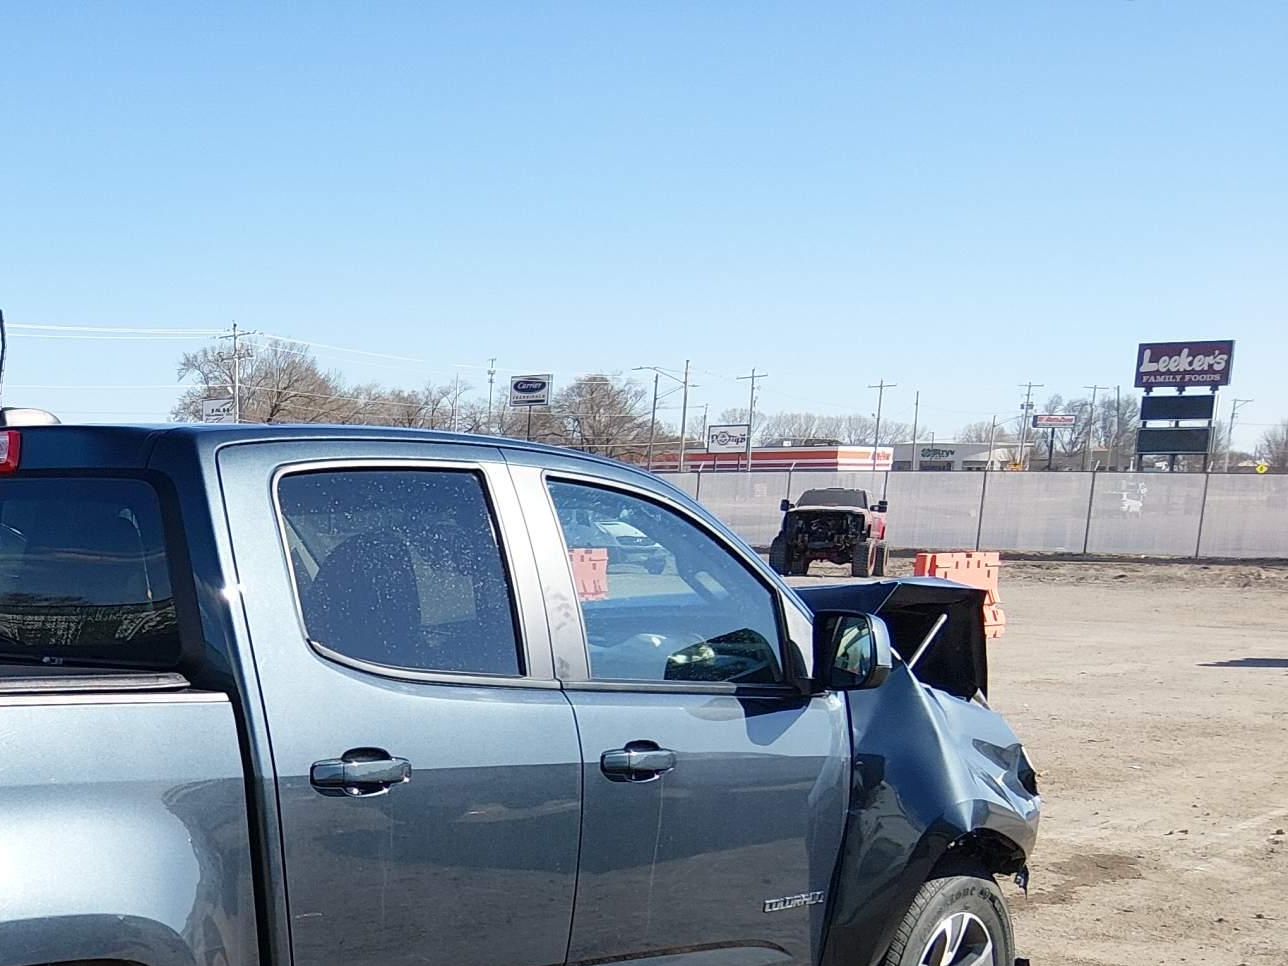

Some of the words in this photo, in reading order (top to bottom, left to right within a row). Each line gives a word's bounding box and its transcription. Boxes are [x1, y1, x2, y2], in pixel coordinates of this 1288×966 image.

[1139, 347, 1228, 372] Leeker's
[1142, 374, 1182, 383] FAMILY
[1184, 373, 1221, 382] FOODS
